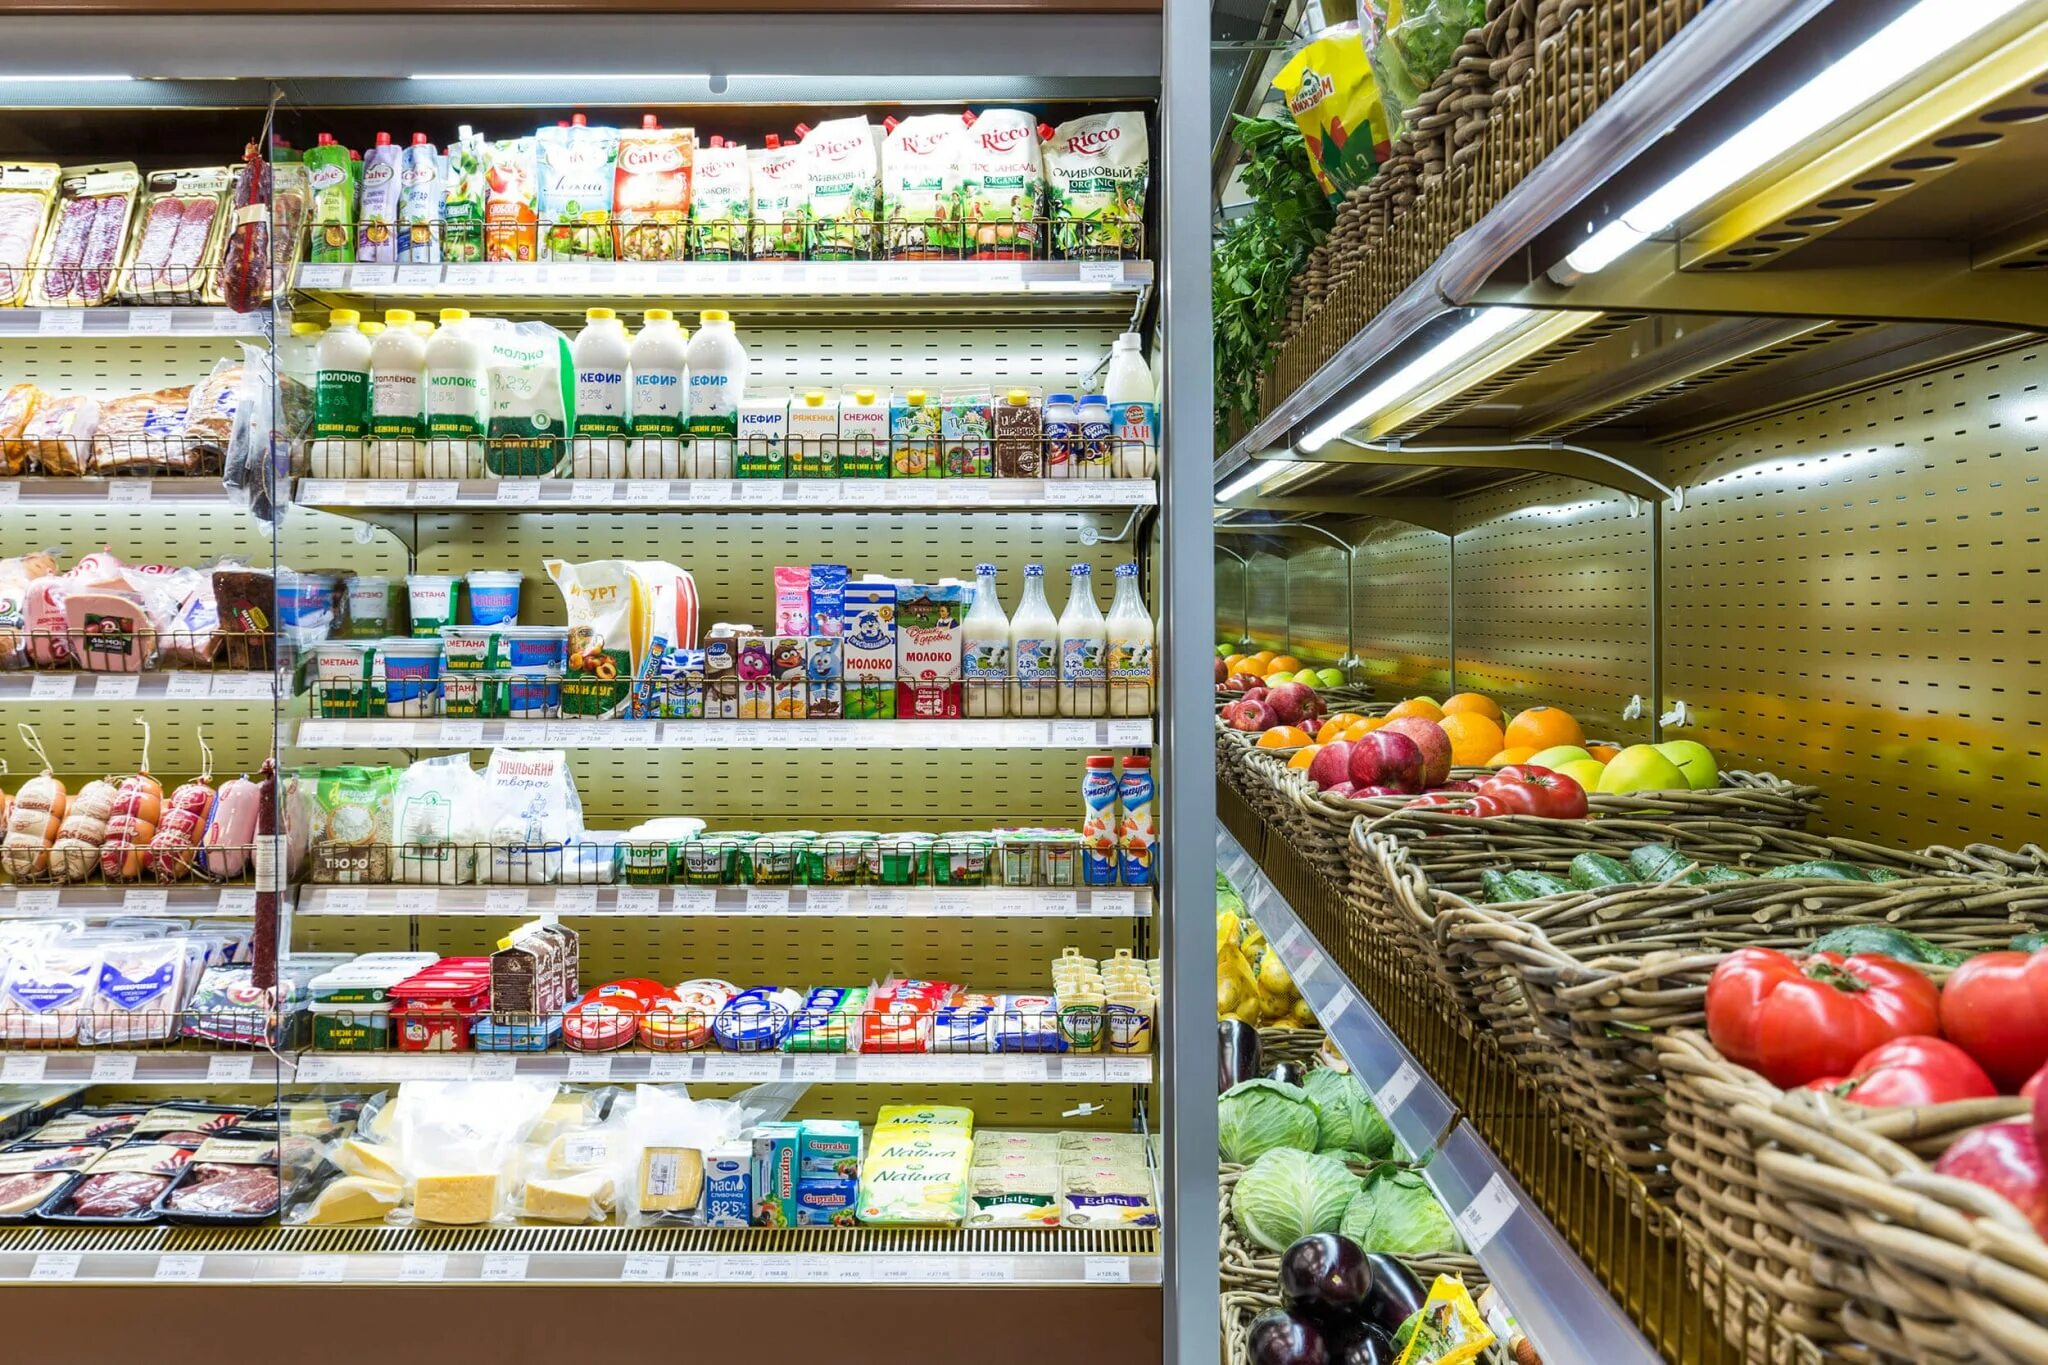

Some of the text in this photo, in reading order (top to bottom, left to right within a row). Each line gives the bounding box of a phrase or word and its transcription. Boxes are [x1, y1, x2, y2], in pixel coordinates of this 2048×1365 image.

[980, 126, 1030, 152] Ricco
[1067, 127, 1120, 154] Ricco
[1053, 165, 1132, 179] ОЛИВКОВЫЙ
[1070, 180, 1113, 189] ORGANIC
[319, 372, 361, 384] МОЛОКО
[580, 372, 622, 384] КЕФИР
[636, 374, 677, 386] КЕФИР
[742, 414, 782, 424] КЕФИР
[793, 413, 835, 423] РЯЖЕНКА
[843, 412, 884, 422] СНЕЖОК
[1121, 425, 1150, 439] ТАН
[447, 640, 486, 648] СМЕТАНА
[320, 658, 359, 666] СМЕТАНА
[906, 652, 952, 662] МОЛОКО
[846, 658, 893, 670] МОЛОКО
[1019, 660, 1037, 669] 2,5%
[1065, 660, 1083, 669] 3,2%
[808, 1140, 850, 1152] Сиртаки
[881, 1146, 955, 1158] Natura
[782, 1147, 794, 1199] Сиртаки
[873, 1169, 951, 1183] Natura
[803, 1193, 847, 1205] Сиртаки
[990, 1195, 1036, 1206] Tilsiter
[1083, 1196, 1129, 1206] Edam
